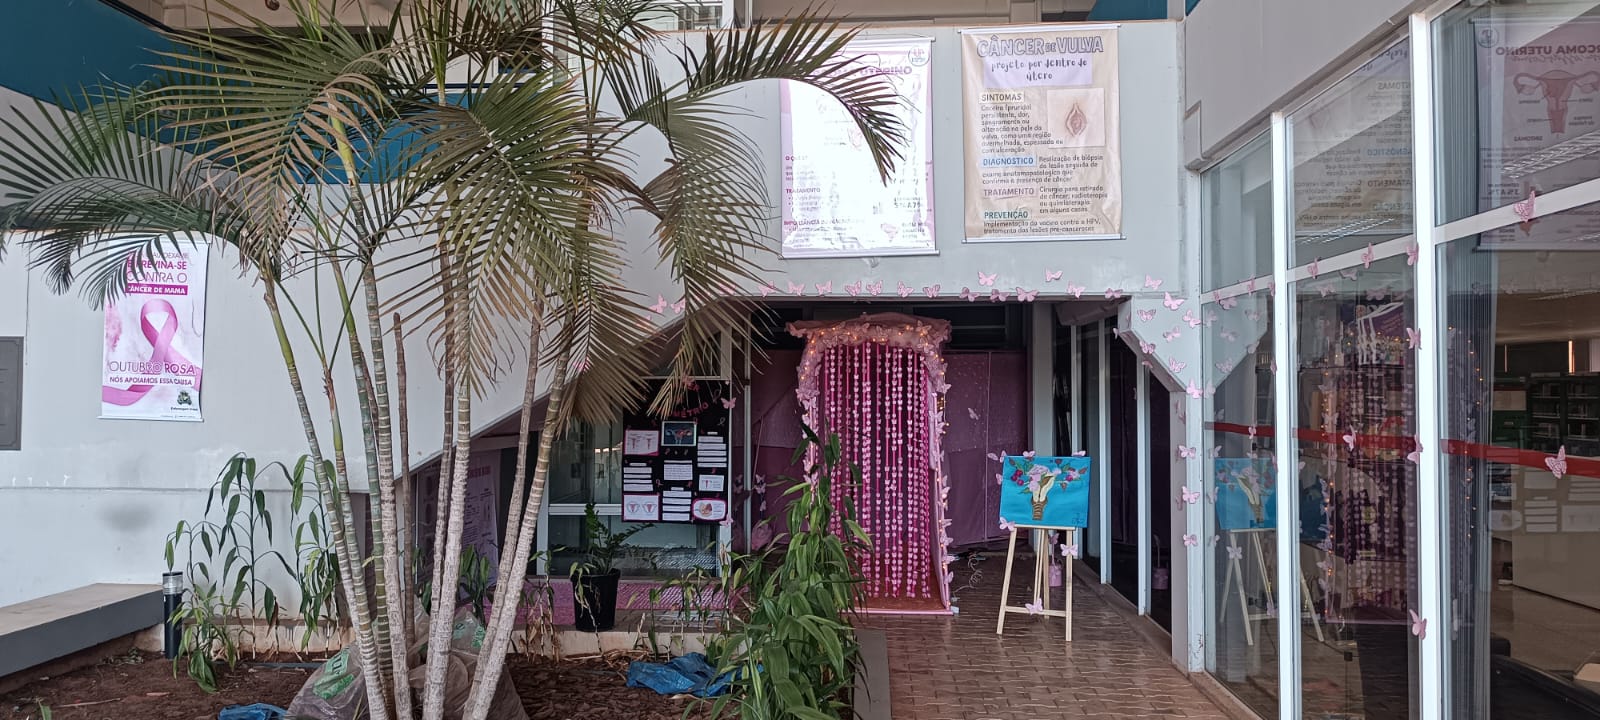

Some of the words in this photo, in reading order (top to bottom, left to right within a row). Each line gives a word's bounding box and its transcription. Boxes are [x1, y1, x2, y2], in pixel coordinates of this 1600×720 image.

[976, 34, 1044, 57] CÂNCER
[1056, 36, 1103, 54] VULVA
[991, 59, 1024, 72] projeto
[1028, 60, 1042, 71] por
[1045, 57, 1075, 68] dentro
[981, 93, 1022, 101] SINTOMAS
[1020, 125, 1033, 133] pele
[983, 187, 1034, 196] TRATAMENTO
[136, 259, 187, 270] REVINA-SE
[177, 272, 188, 283] O
[109, 360, 163, 373] OUTUBRO
[164, 361, 196, 375] ROSA
[124, 376, 158, 384] APOIAMOS
